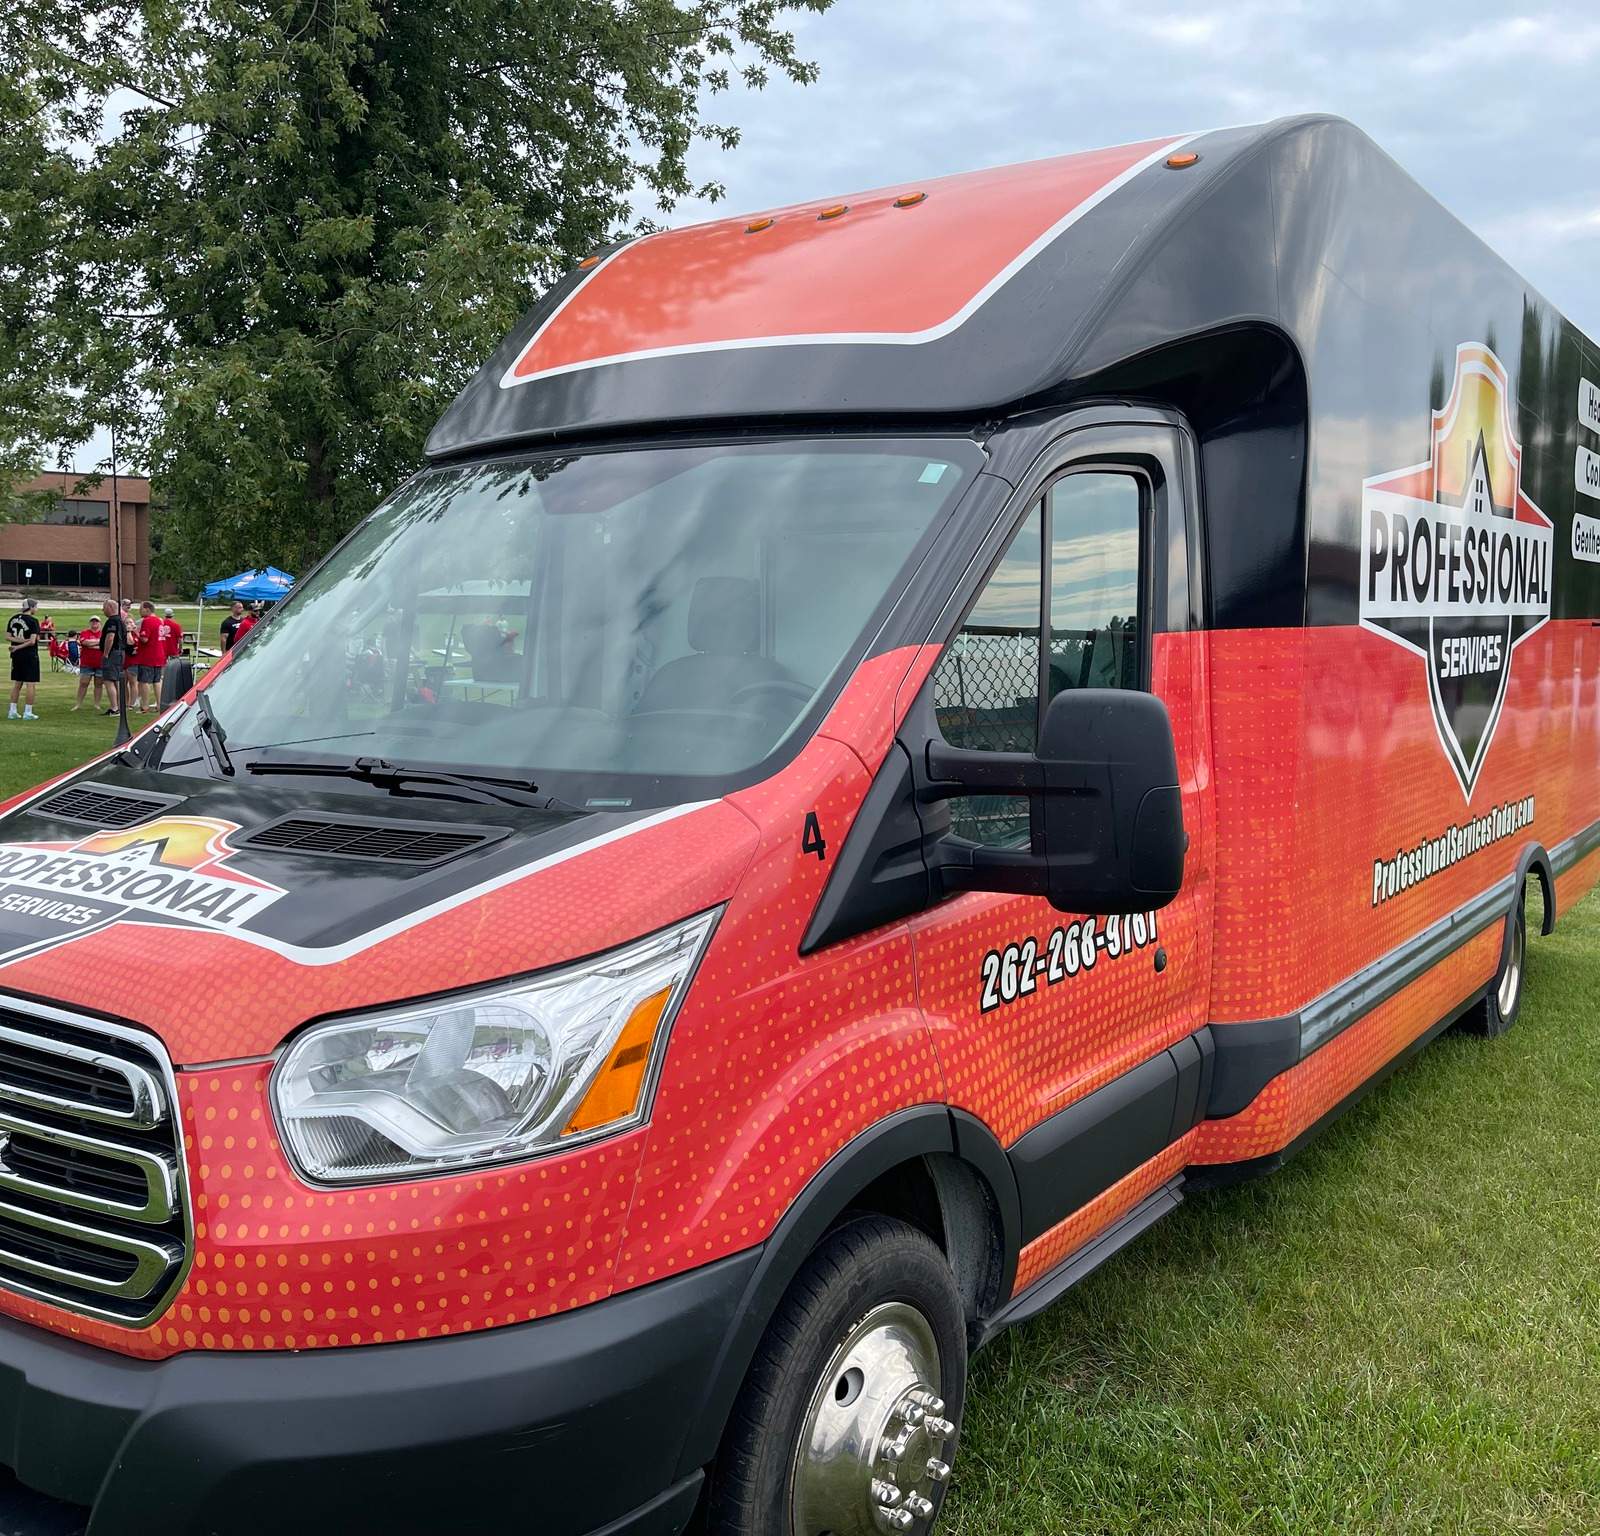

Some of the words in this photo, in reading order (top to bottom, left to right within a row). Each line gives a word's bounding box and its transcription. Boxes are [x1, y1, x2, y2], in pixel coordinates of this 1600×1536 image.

[1368, 510, 1548, 604] PROFESSIONAL
[1440, 634, 1501, 678] SERVICES
[802, 811, 826, 861] 4
[1371, 795, 1535, 908] ProfessionalServicesToday.com
[0, 851, 258, 924] OFESSIONAL
[0, 893, 102, 925] SERVICES
